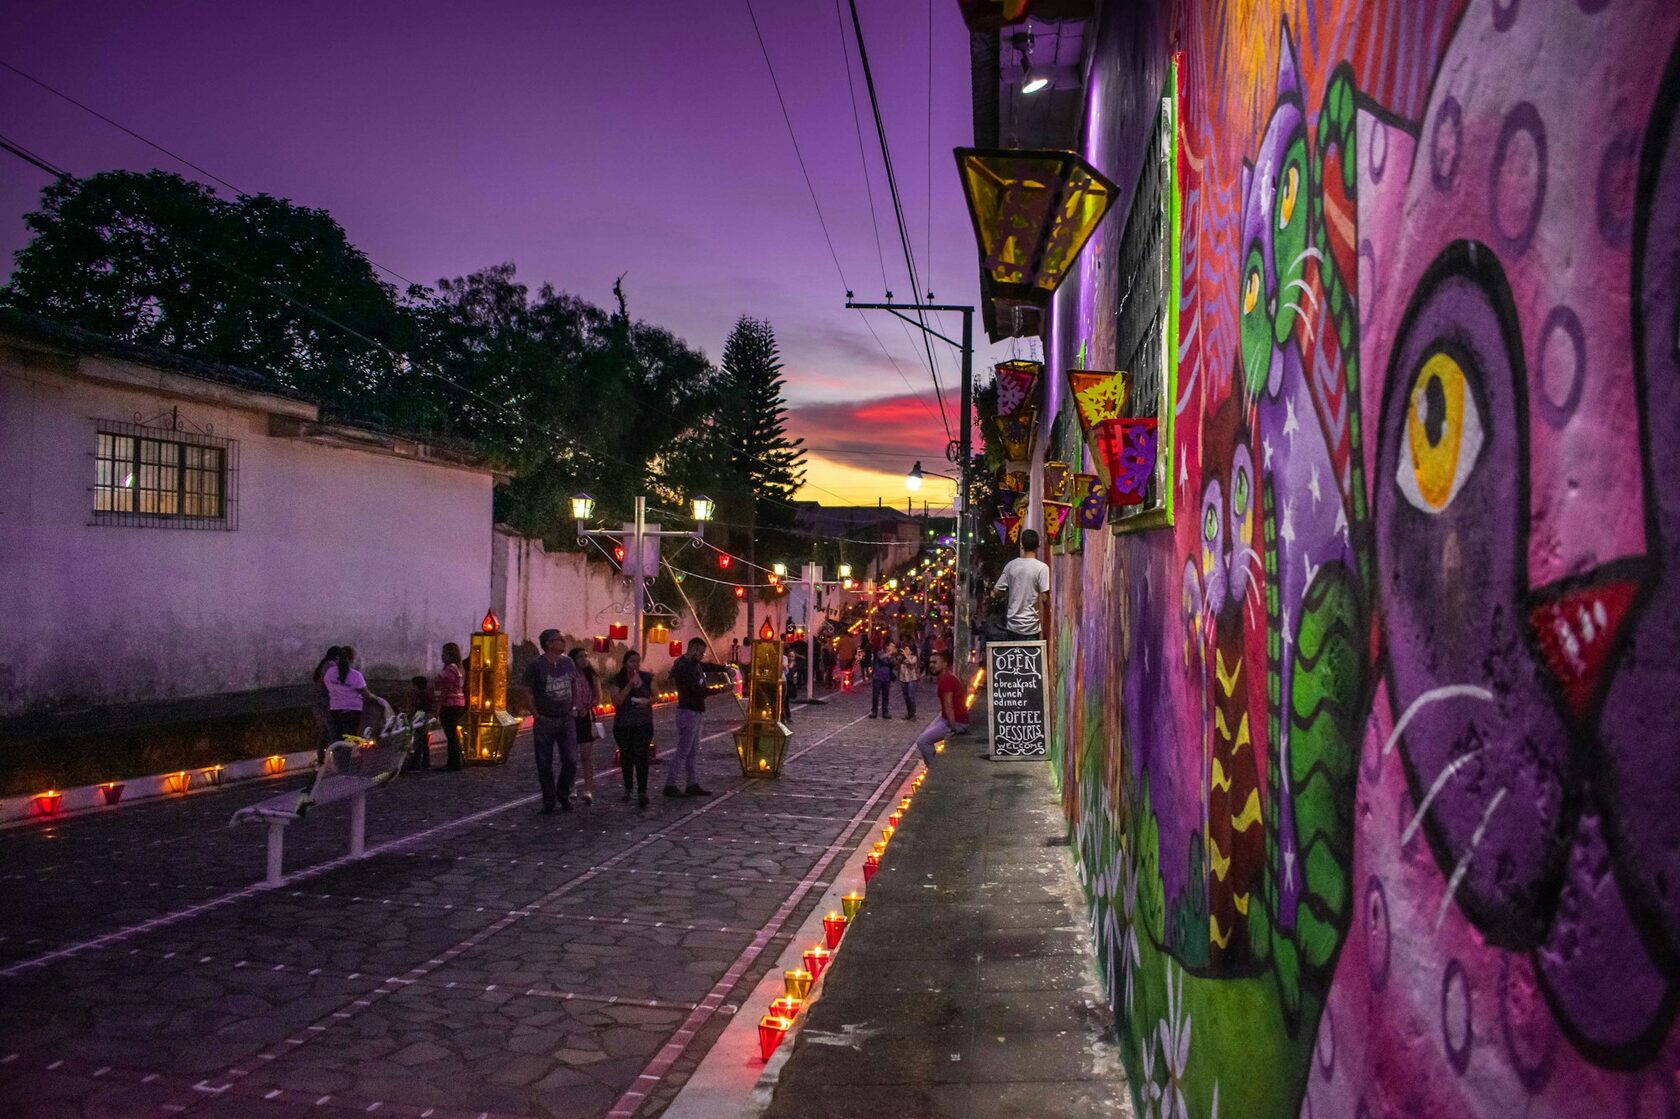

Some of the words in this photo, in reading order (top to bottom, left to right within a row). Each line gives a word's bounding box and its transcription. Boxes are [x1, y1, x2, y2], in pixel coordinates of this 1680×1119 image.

[995, 654, 1037, 673] OPEN
[1000, 678, 1037, 692] breakfast
[998, 688, 1022, 698] lunch
[999, 698, 1027, 706] dinner
[997, 711, 1041, 723] COFFEE
[999, 725, 1041, 740] DESSERTS
